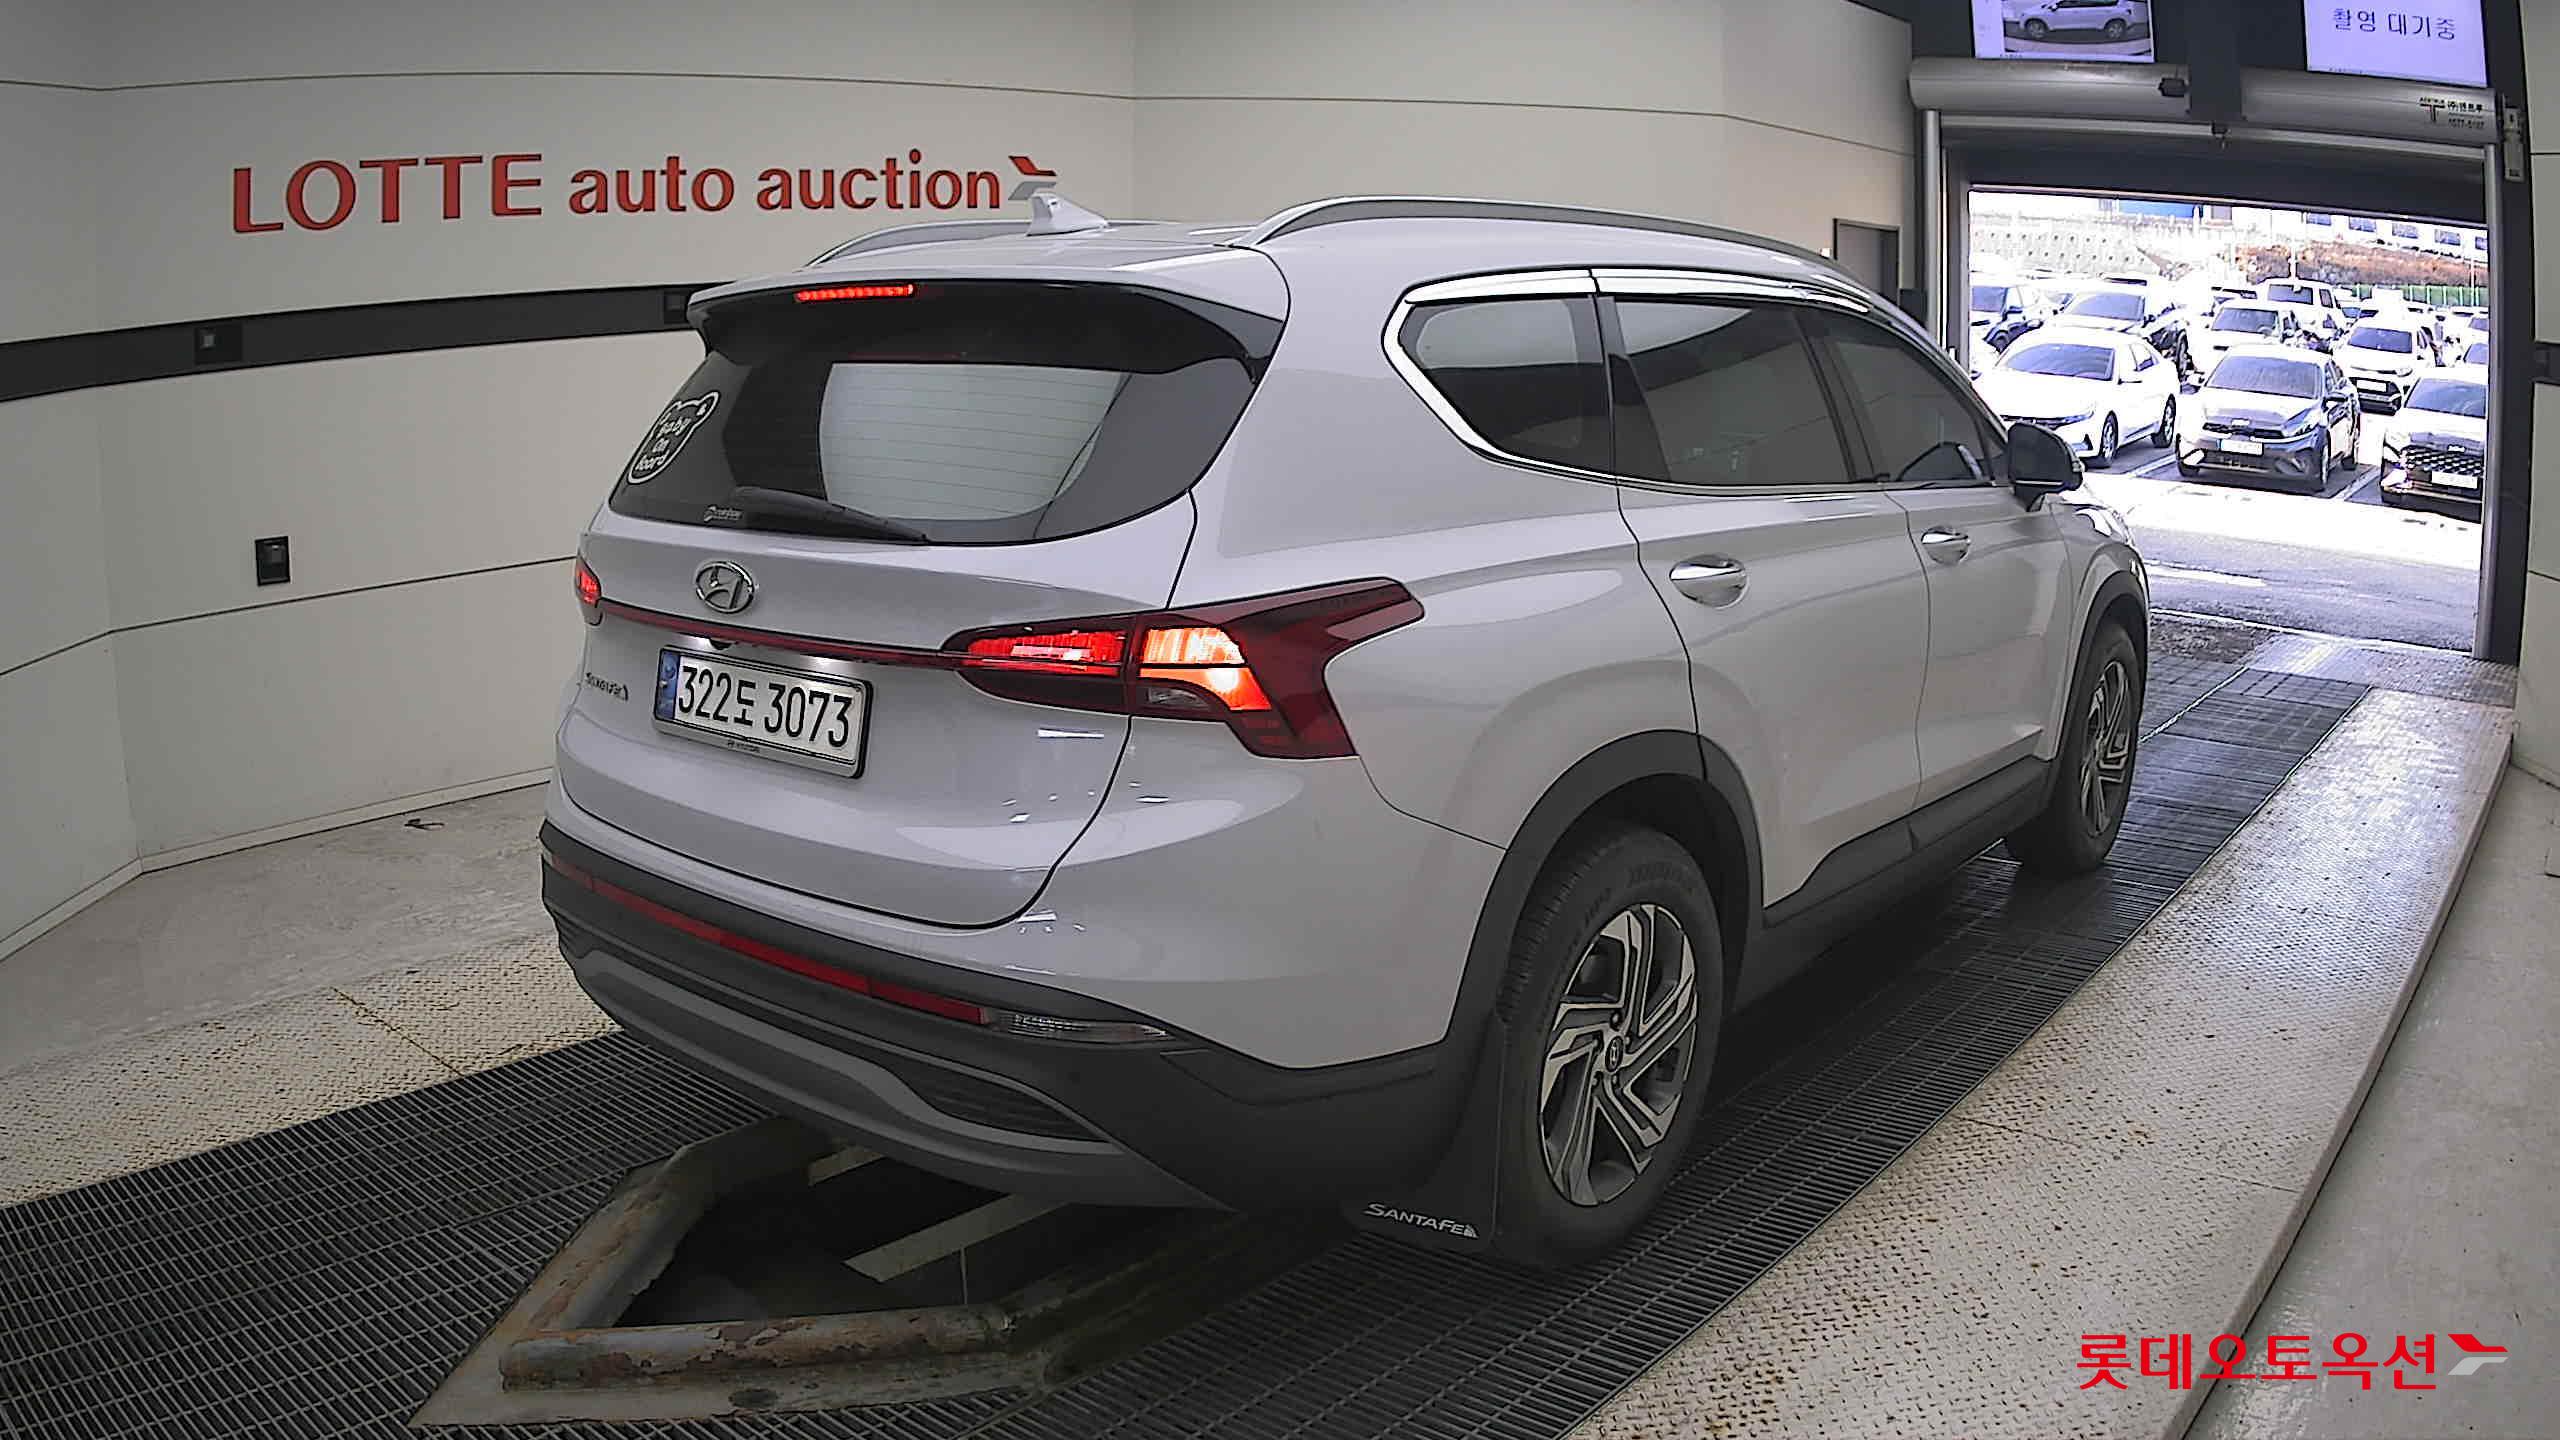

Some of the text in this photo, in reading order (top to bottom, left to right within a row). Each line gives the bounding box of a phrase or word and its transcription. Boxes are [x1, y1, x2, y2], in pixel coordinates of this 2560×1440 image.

[2333, 8, 2456, 41] 촬영 대기중
[233, 148, 1001, 233] LOTTE auto auction
